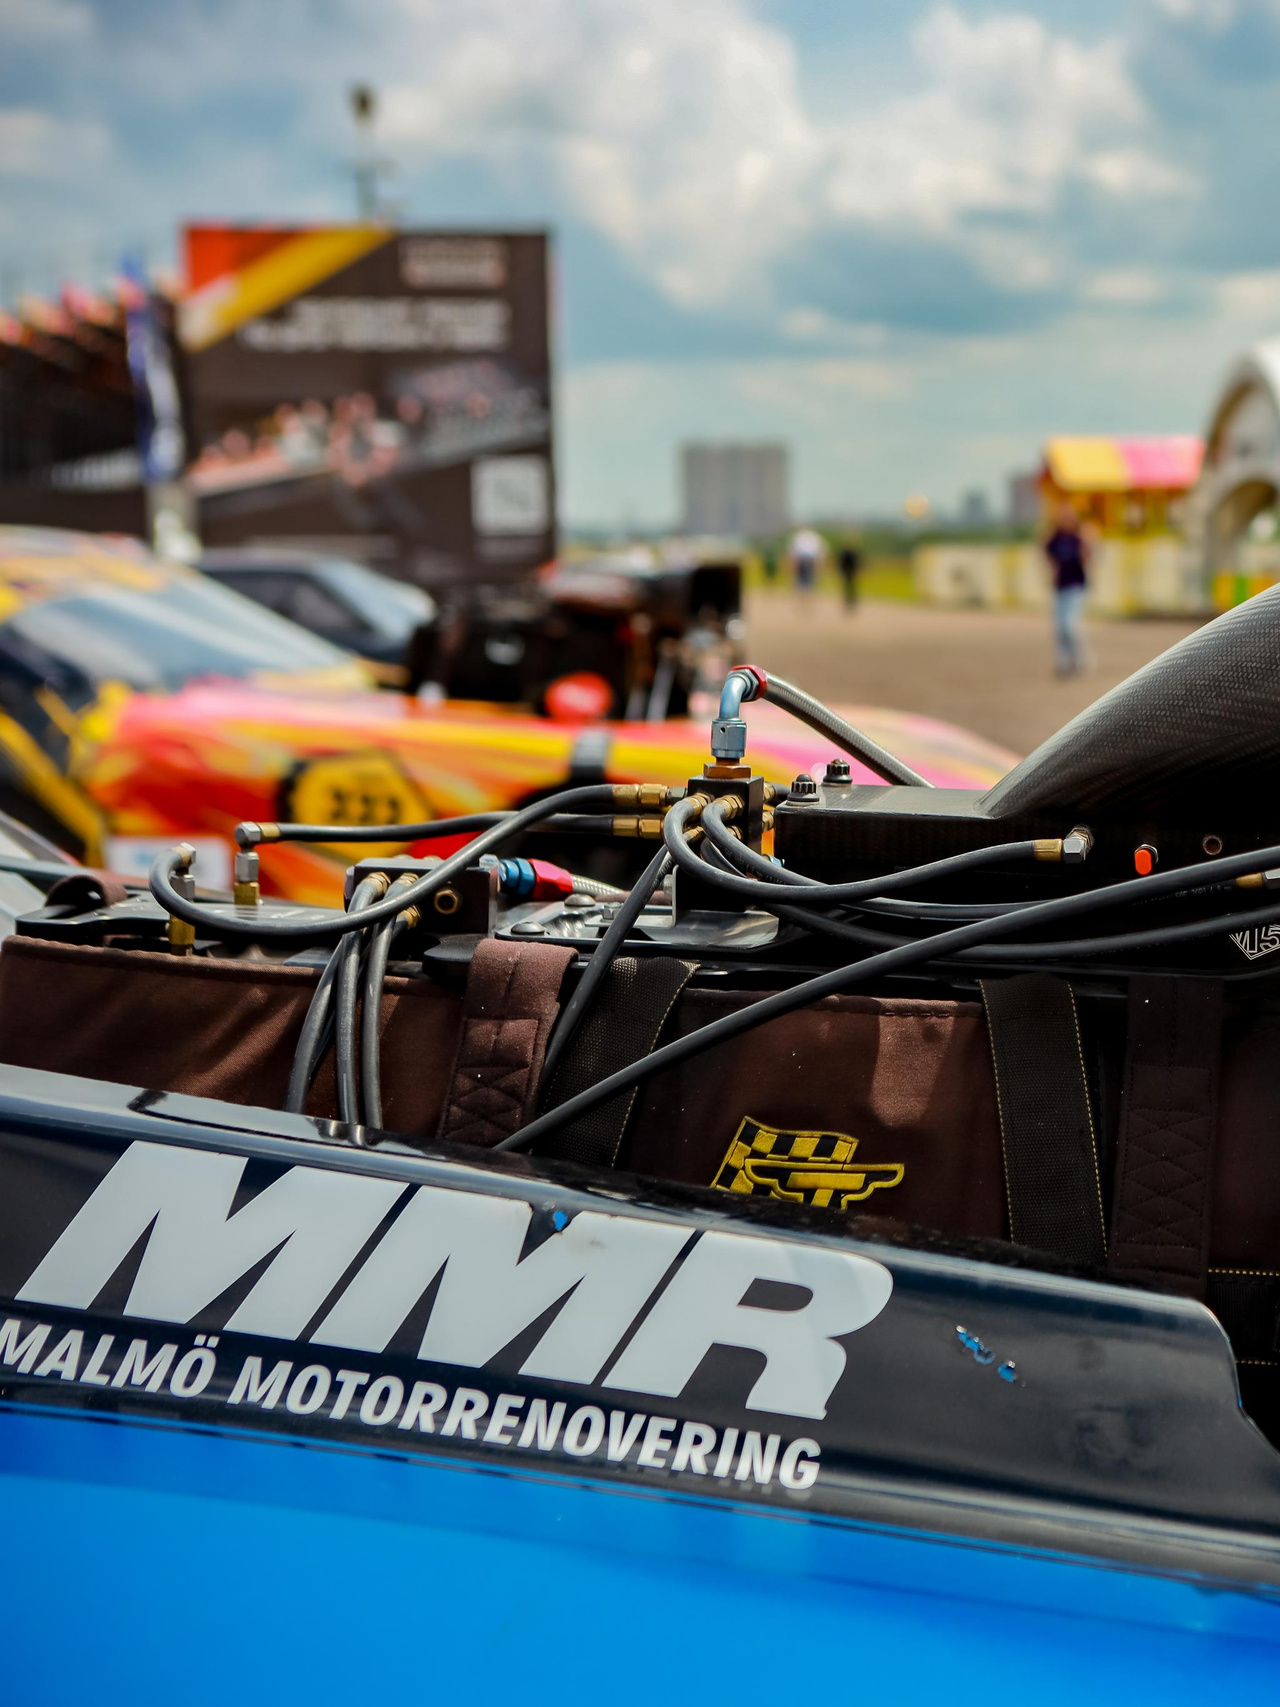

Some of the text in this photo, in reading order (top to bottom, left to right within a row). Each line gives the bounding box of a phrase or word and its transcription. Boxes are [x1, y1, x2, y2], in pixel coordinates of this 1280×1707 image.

[14, 1140, 894, 1420] MMR
[0, 1318, 822, 1490] MALMÖ MOTORRENOVERING
